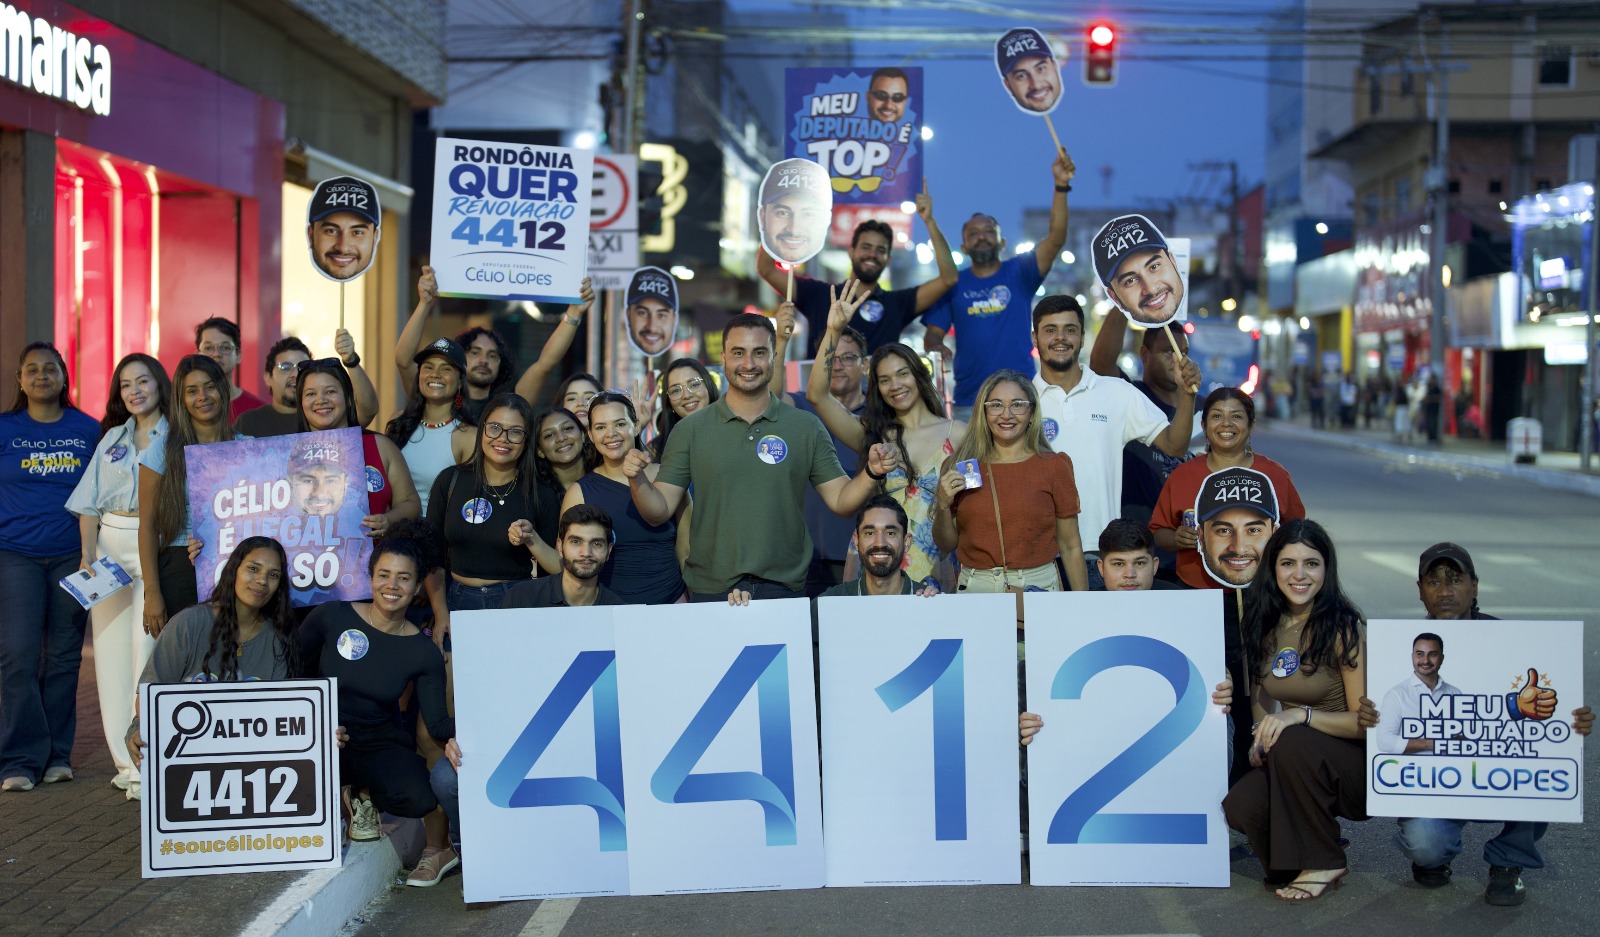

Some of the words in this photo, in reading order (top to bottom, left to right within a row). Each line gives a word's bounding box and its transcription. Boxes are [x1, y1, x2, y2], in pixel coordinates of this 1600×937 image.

[0, 1, 111, 116] marisa
[1006, 38, 1040, 57] 4412
[811, 92, 858, 116] MEU
[800, 116, 896, 142] DEPUTADO
[898, 123, 912, 144] É
[454, 145, 574, 169] RONDÔNIA
[448, 163, 578, 203] QUER
[325, 192, 368, 210] 4412
[448, 196, 575, 221] RENOVAÇÃO
[451, 216, 566, 250] 4412
[589, 234, 622, 252] AXI
[1108, 229, 1148, 259] 4412
[465, 266, 505, 283] CÉLIO
[508, 269, 552, 286] LOPES
[638, 280, 669, 297] 4412
[21, 458, 40, 468] DE
[43, 457, 81, 468] QUEM
[30, 451, 74, 460] PERTO
[303, 448, 339, 462] 4412
[29, 464, 76, 476] espera
[214, 480, 291, 519] CÉLIO
[1214, 485, 1262, 504] 4412
[219, 521, 235, 555] É
[1420, 694, 1503, 721] MEU
[212, 717, 268, 739] ALTO
[275, 716, 306, 736] EM
[1402, 717, 1570, 743] DEPUTADO
[486, 650, 627, 852] 4
[650, 643, 797, 847] 4
[874, 639, 967, 841] 1
[1047, 634, 1208, 844] 2
[1433, 739, 1538, 757] FEDERAL
[1376, 759, 1462, 789] CÉLIO
[1471, 761, 1570, 792] LOPES
[182, 766, 299, 816] 4412
[160, 834, 324, 856] #soucéliolopes
